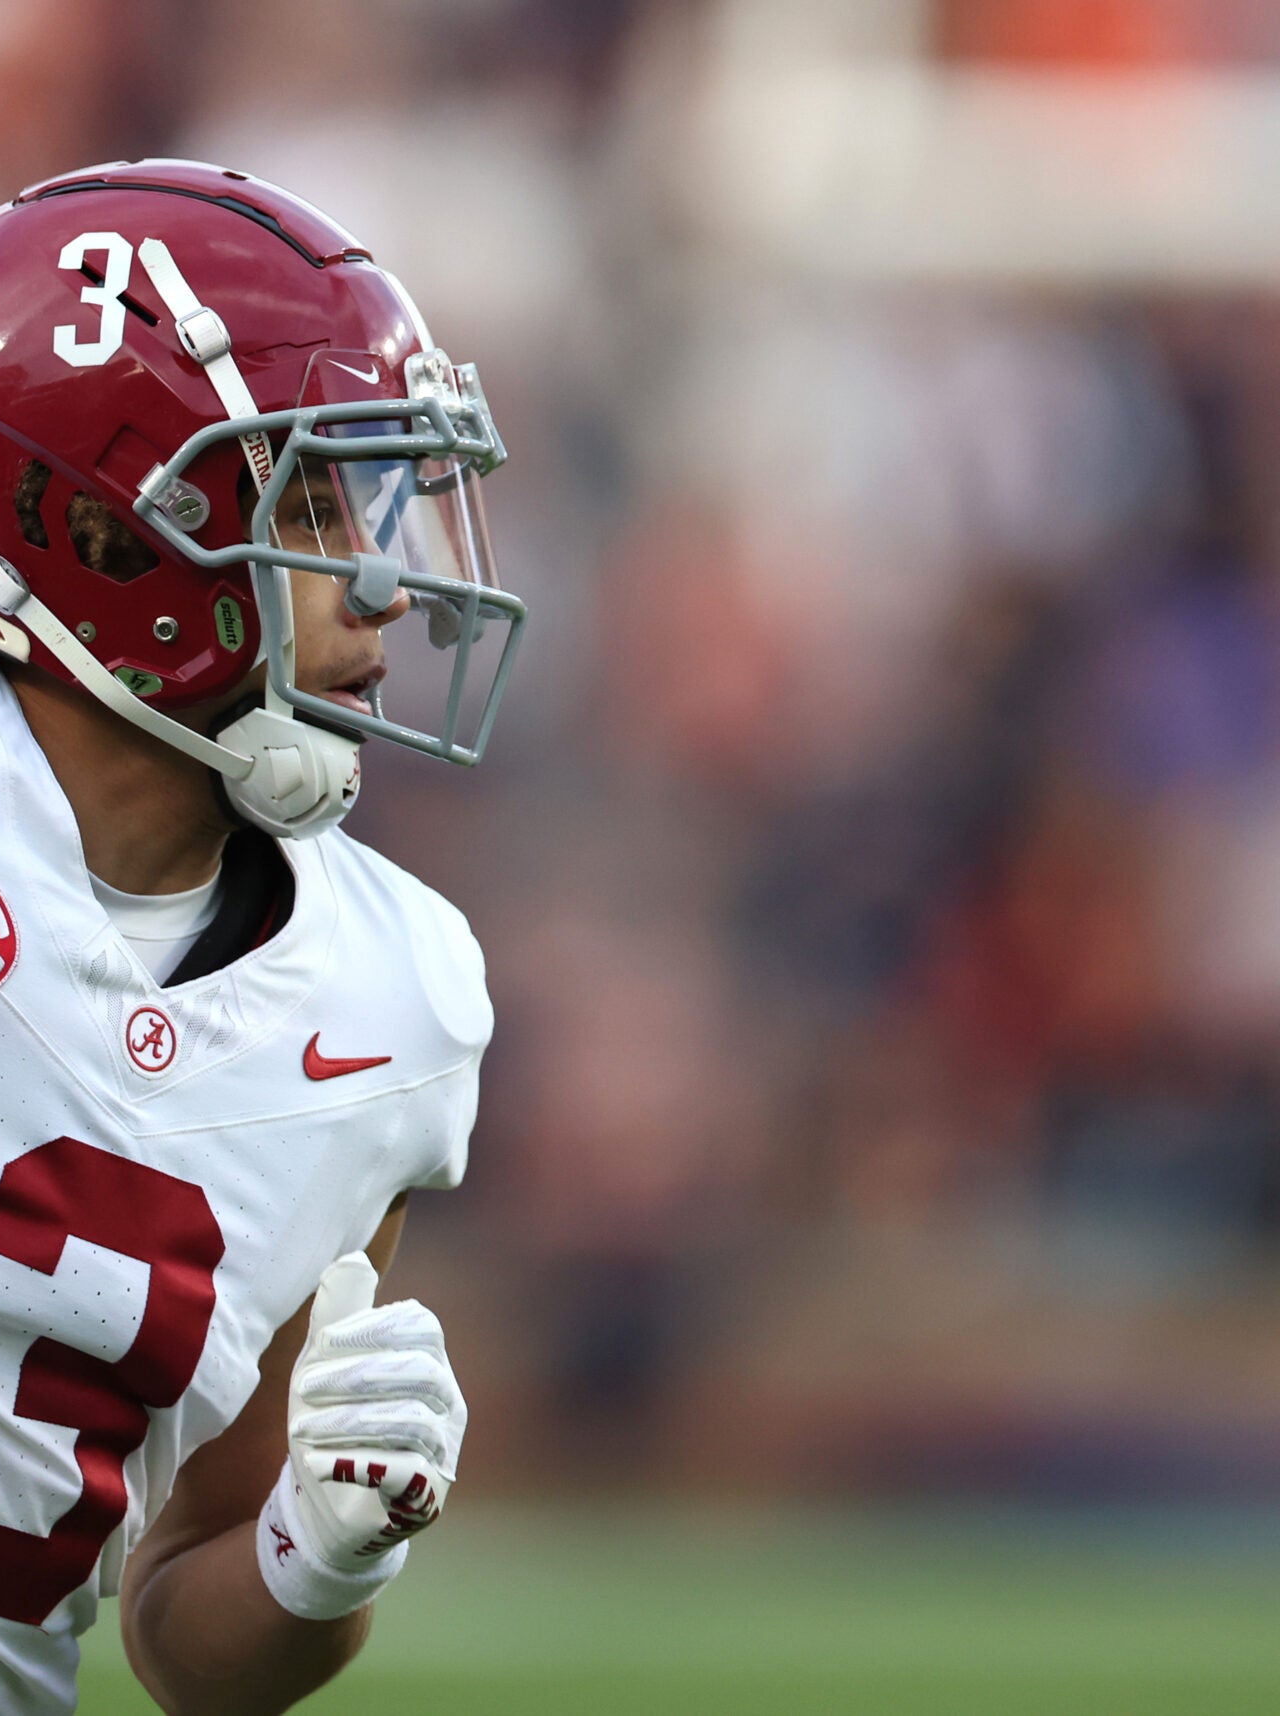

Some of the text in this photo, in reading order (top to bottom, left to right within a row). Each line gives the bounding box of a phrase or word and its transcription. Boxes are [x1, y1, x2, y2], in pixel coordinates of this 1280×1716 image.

[53, 231, 134, 367] 3
[244, 431, 271, 489] CRIM
[221, 603, 238, 645] schutt
[132, 1018, 165, 1059] A
